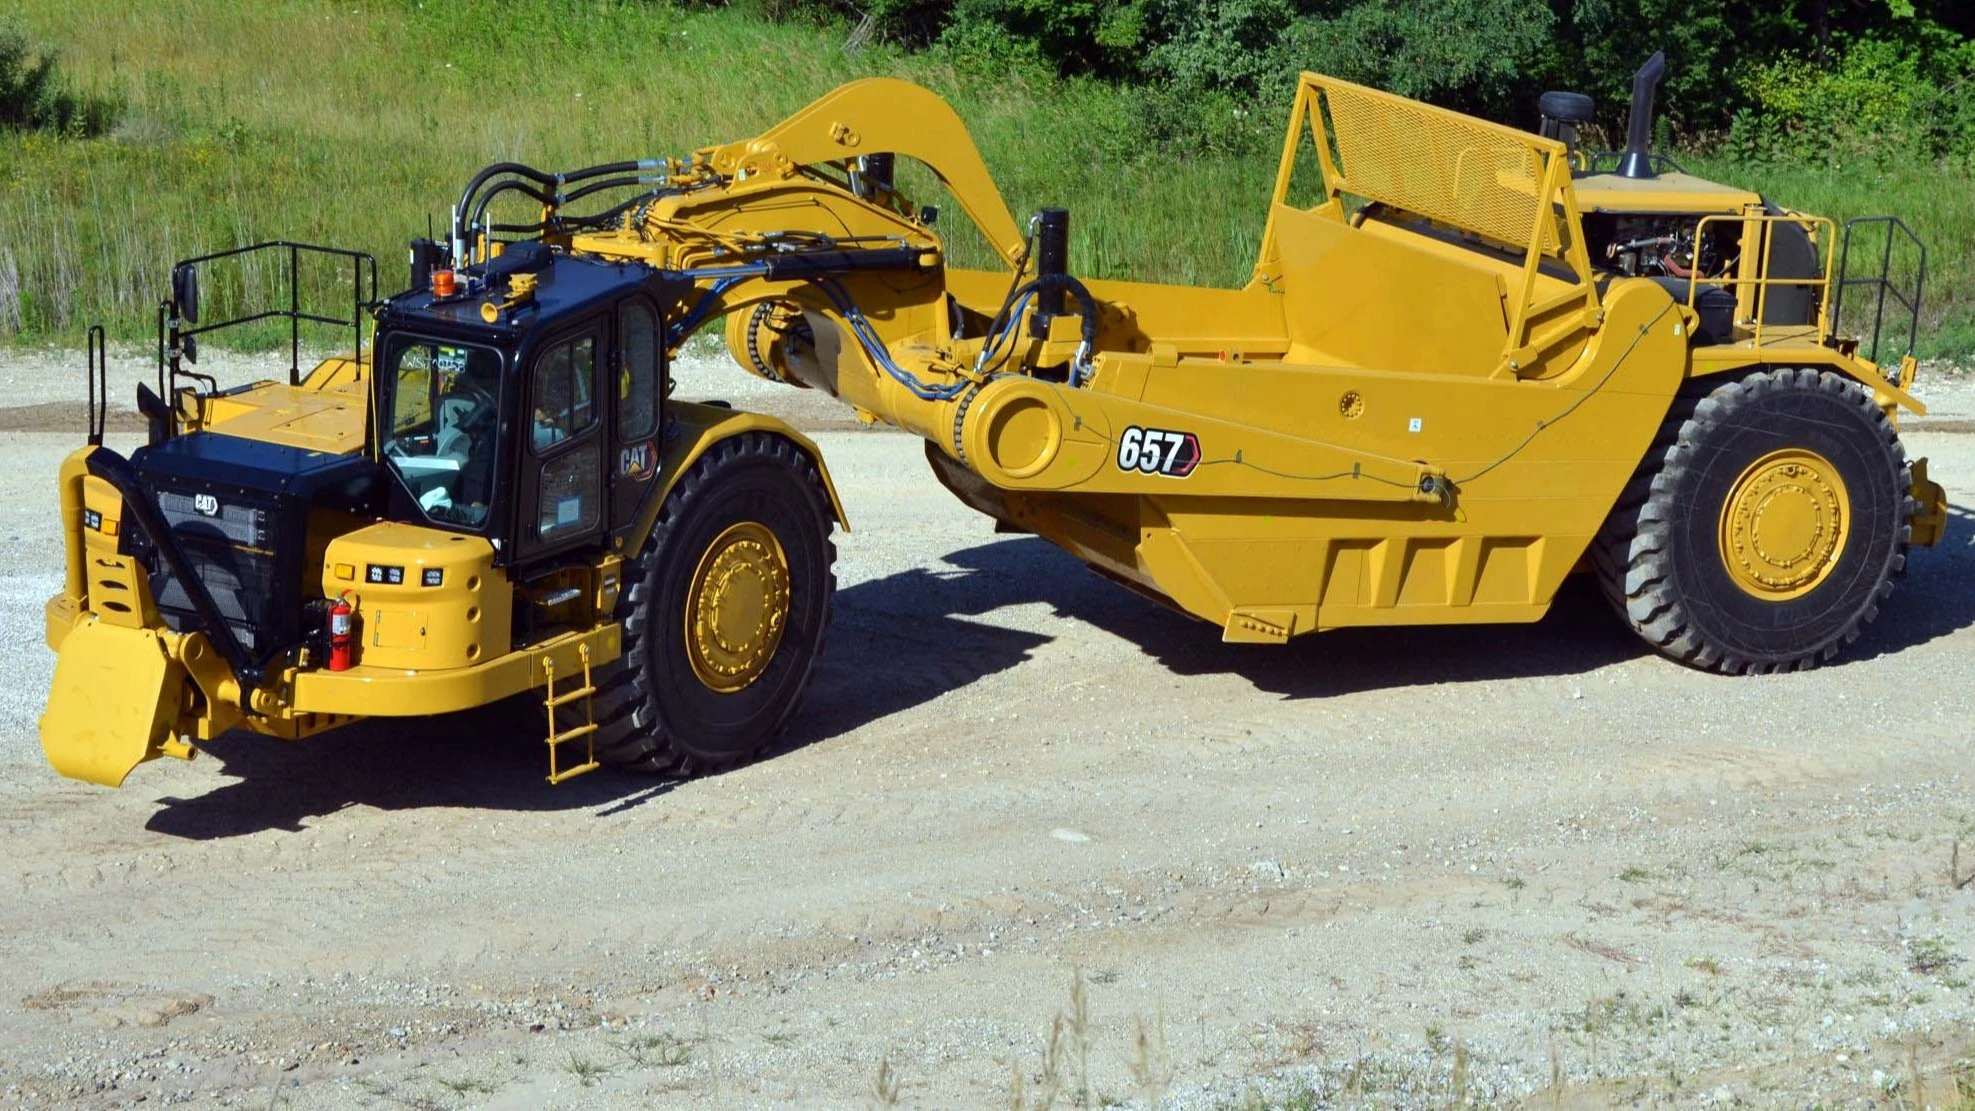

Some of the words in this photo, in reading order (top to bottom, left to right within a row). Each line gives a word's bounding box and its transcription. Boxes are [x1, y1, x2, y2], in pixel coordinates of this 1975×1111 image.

[620, 443, 648, 476] CAT
[1118, 426, 1185, 473] 657
[195, 494, 213, 511] CAT
